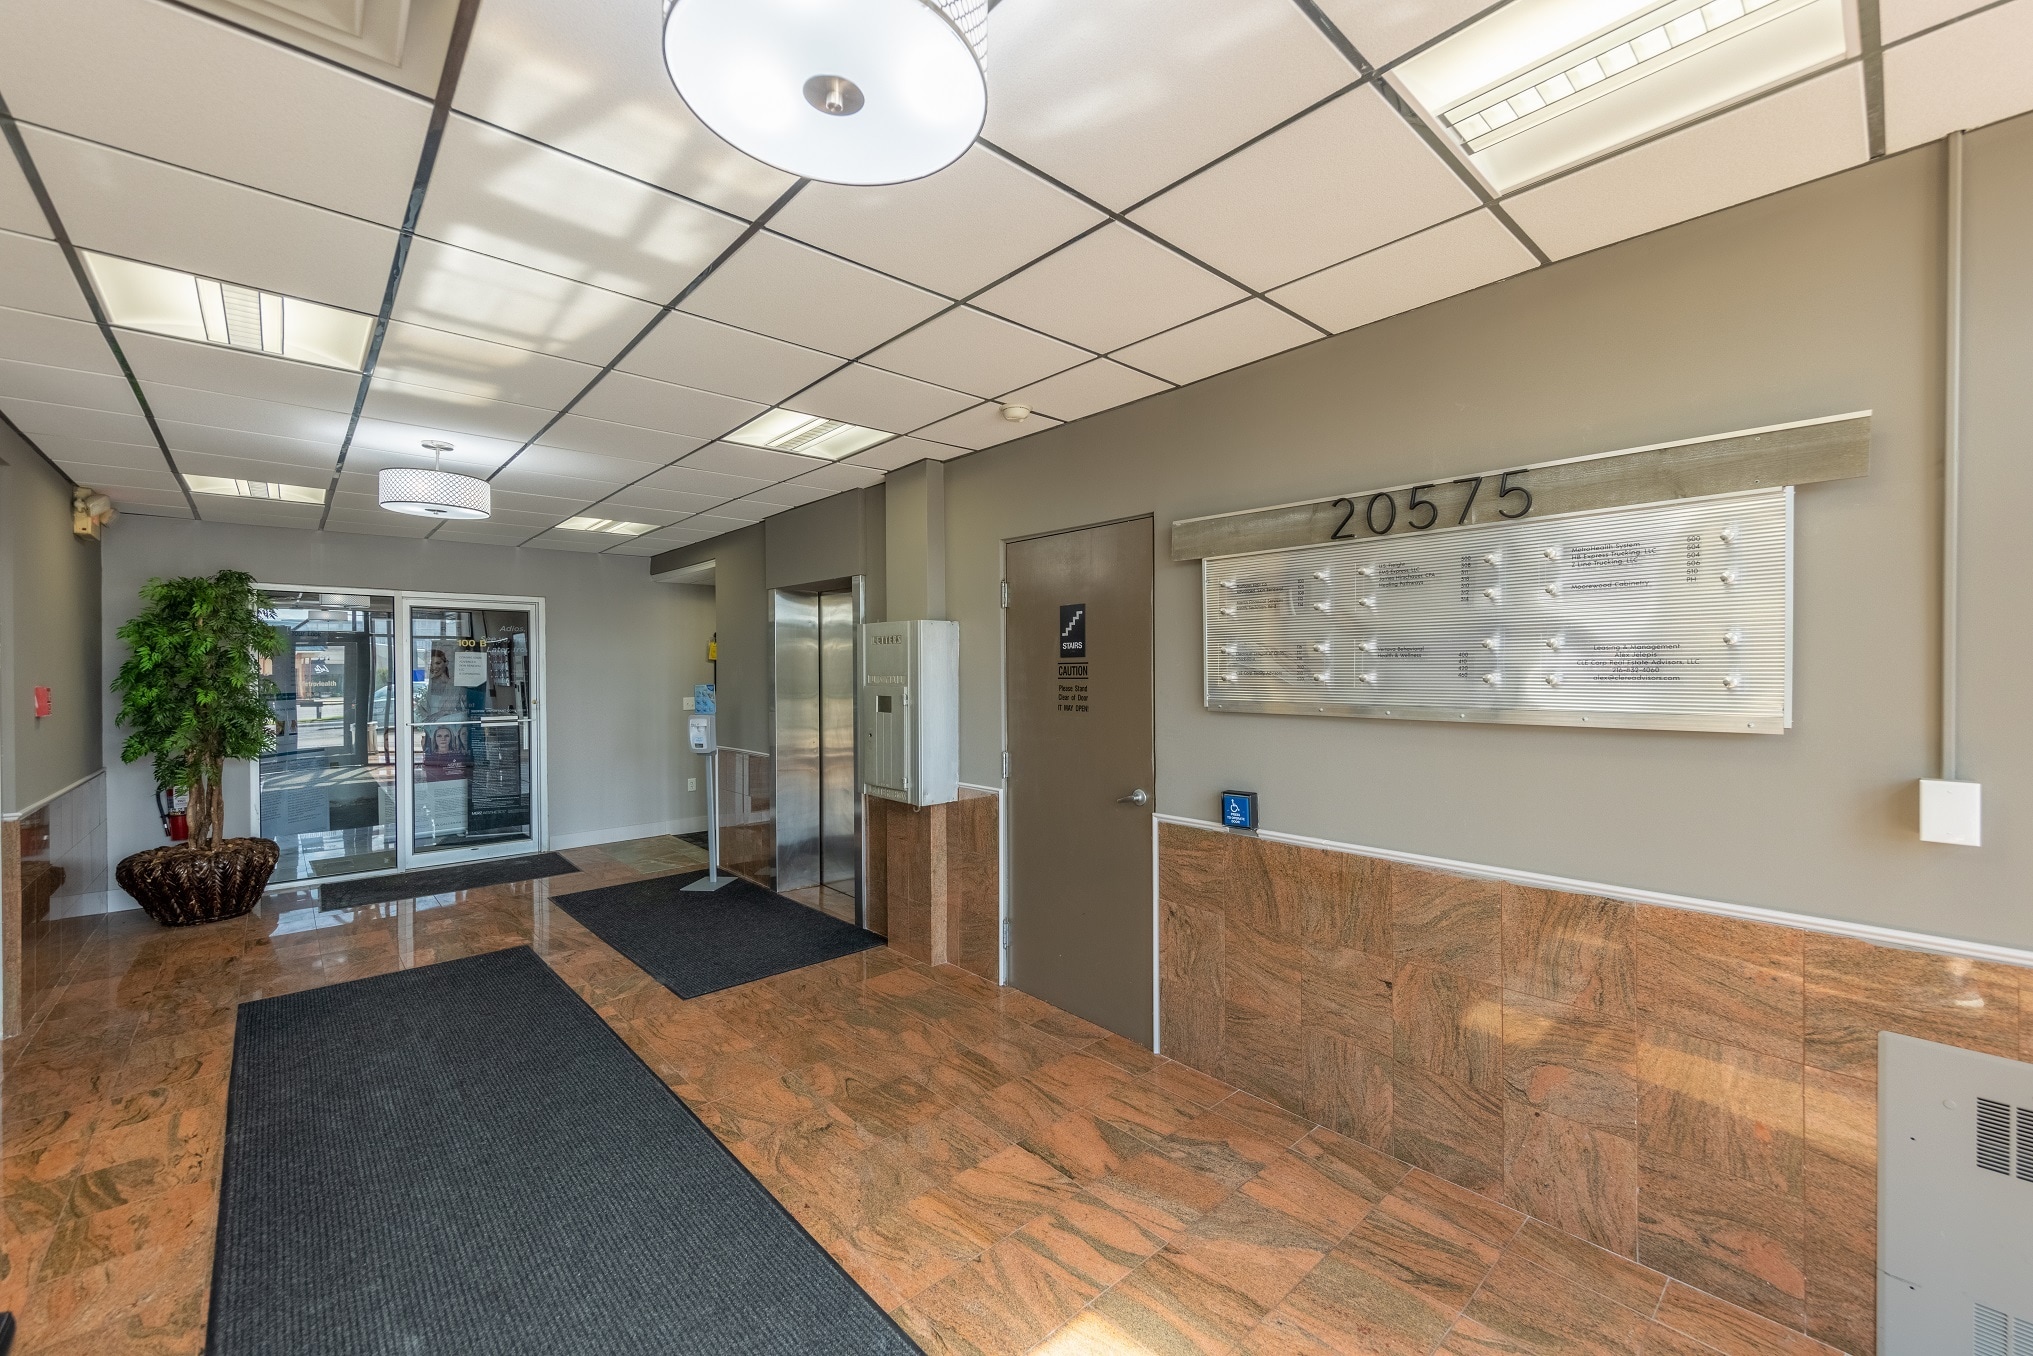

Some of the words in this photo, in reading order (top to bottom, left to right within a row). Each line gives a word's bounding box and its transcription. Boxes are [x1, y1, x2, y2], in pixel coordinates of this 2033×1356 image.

[1331, 468, 1533, 540] 20575
[1571, 543, 1614, 552] MetroHealth
[1583, 551, 1609, 559] Express
[1571, 581, 1612, 590] Moorewood
[1614, 580, 1650, 588] Cabinetry
[456, 639, 476, 647] 100
[480, 639, 487, 647] B
[871, 635, 902, 645] LETTERS
[1630, 643, 1680, 651] Management
[1058, 665, 1088, 676] CAUTION
[1059, 684, 1074, 692] Please
[1074, 684, 1088, 692] Stand
[1058, 693, 1070, 701] Clear
[1077, 694, 1089, 702] Door
[1063, 704, 1074, 712] MAY
